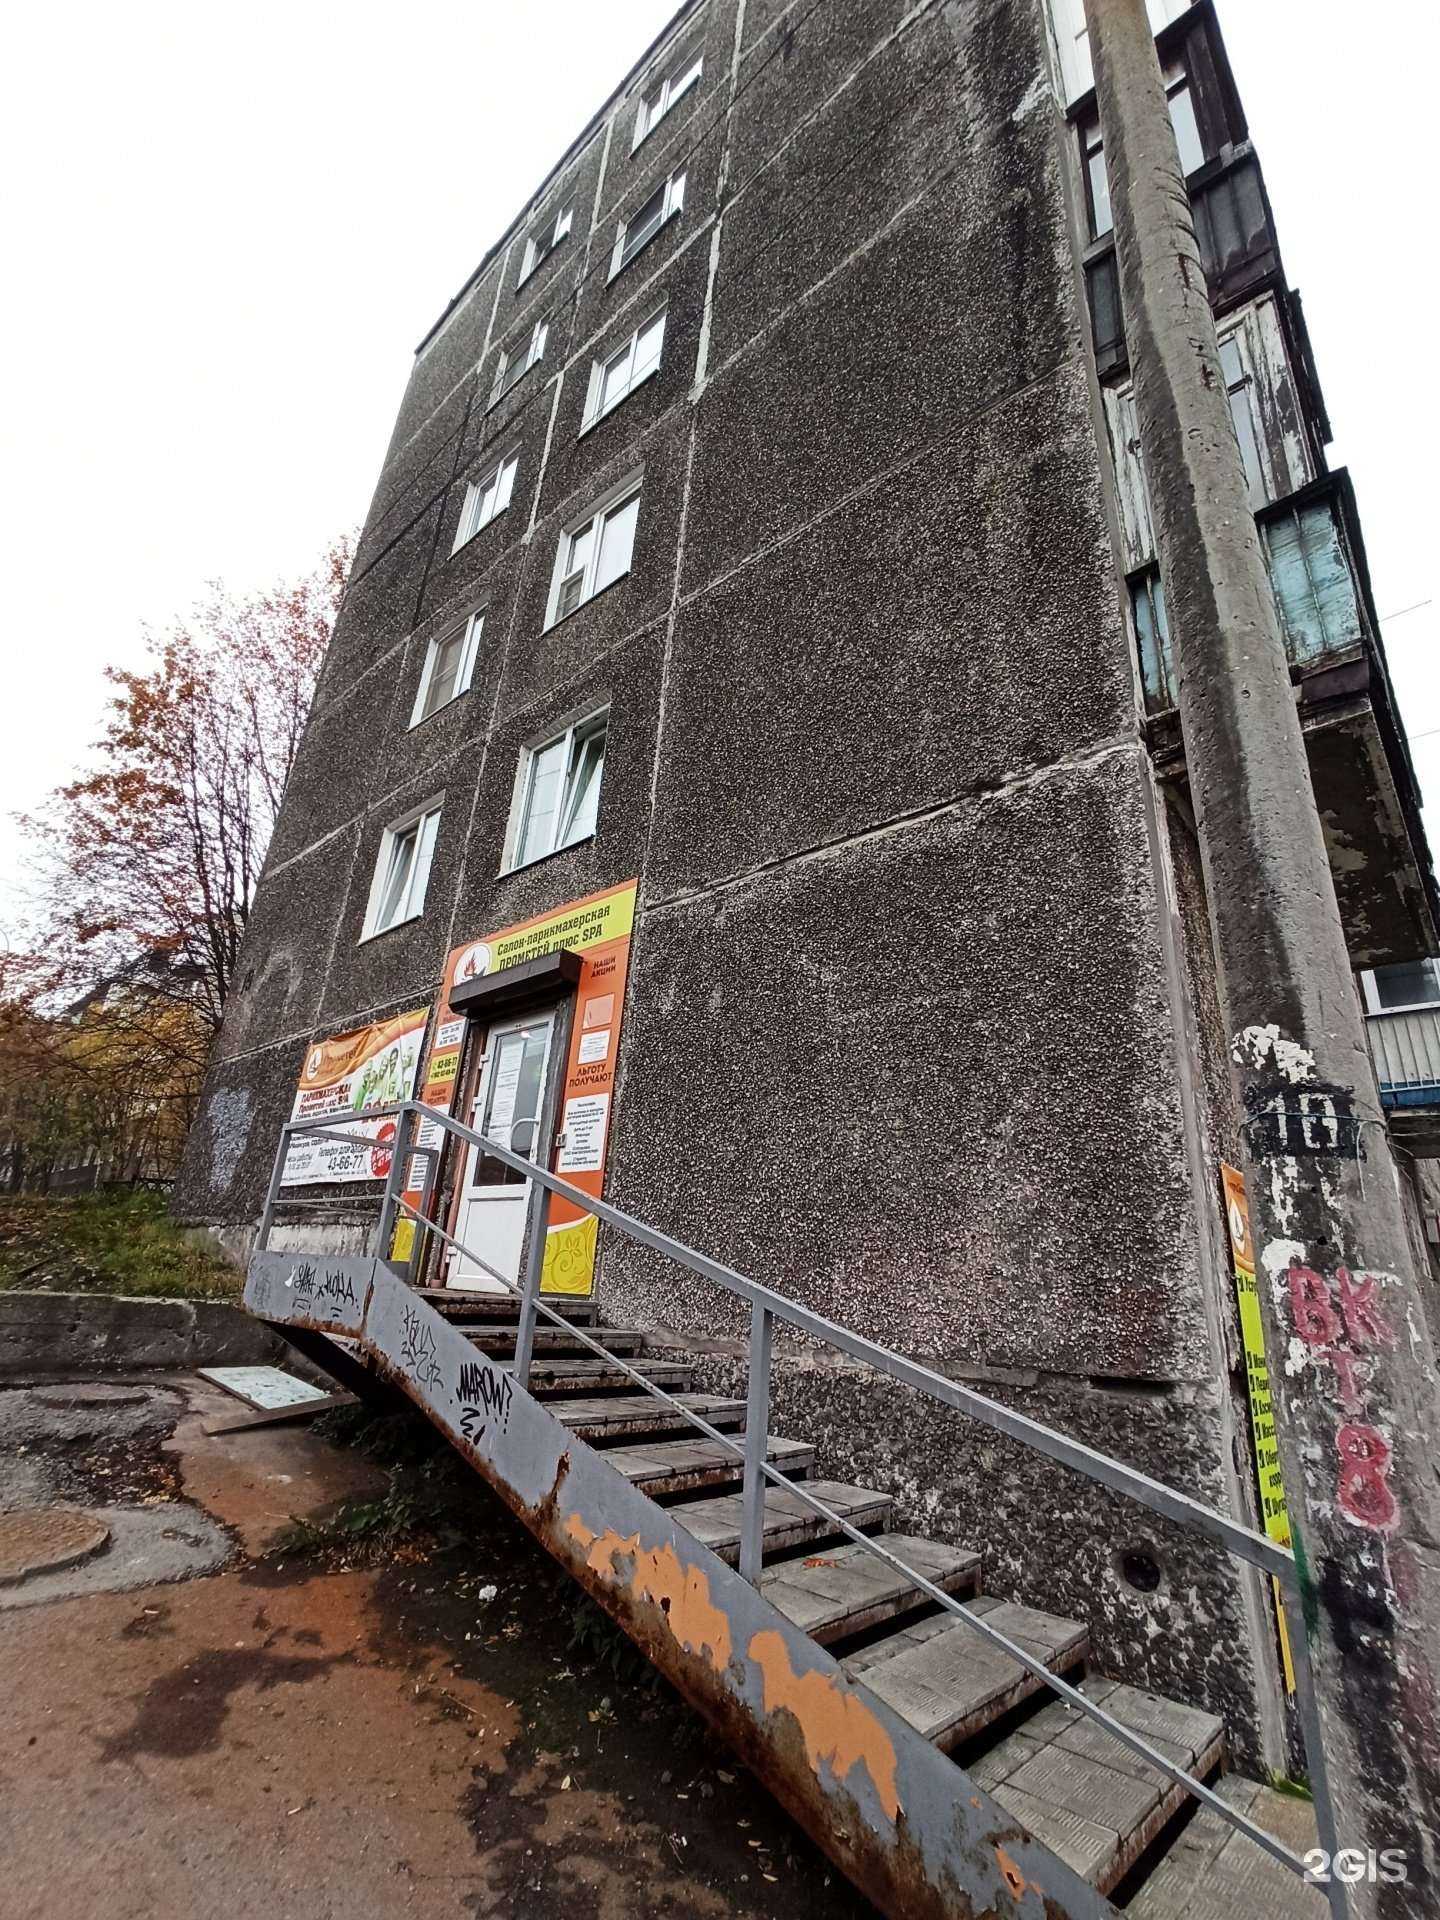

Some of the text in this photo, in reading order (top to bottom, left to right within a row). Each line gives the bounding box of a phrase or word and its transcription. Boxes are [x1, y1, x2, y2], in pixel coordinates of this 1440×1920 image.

[497, 904, 611, 957] Салон-парикмахерская
[499, 940, 550, 972] ПРОМЕТЕЙ
[582, 923, 604, 944] SPA
[593, 955, 617, 969] НАШИ
[576, 1063, 607, 1078] ЛЬГОТУ
[568, 1072, 613, 1088] ПОЛУЧАЮТ
